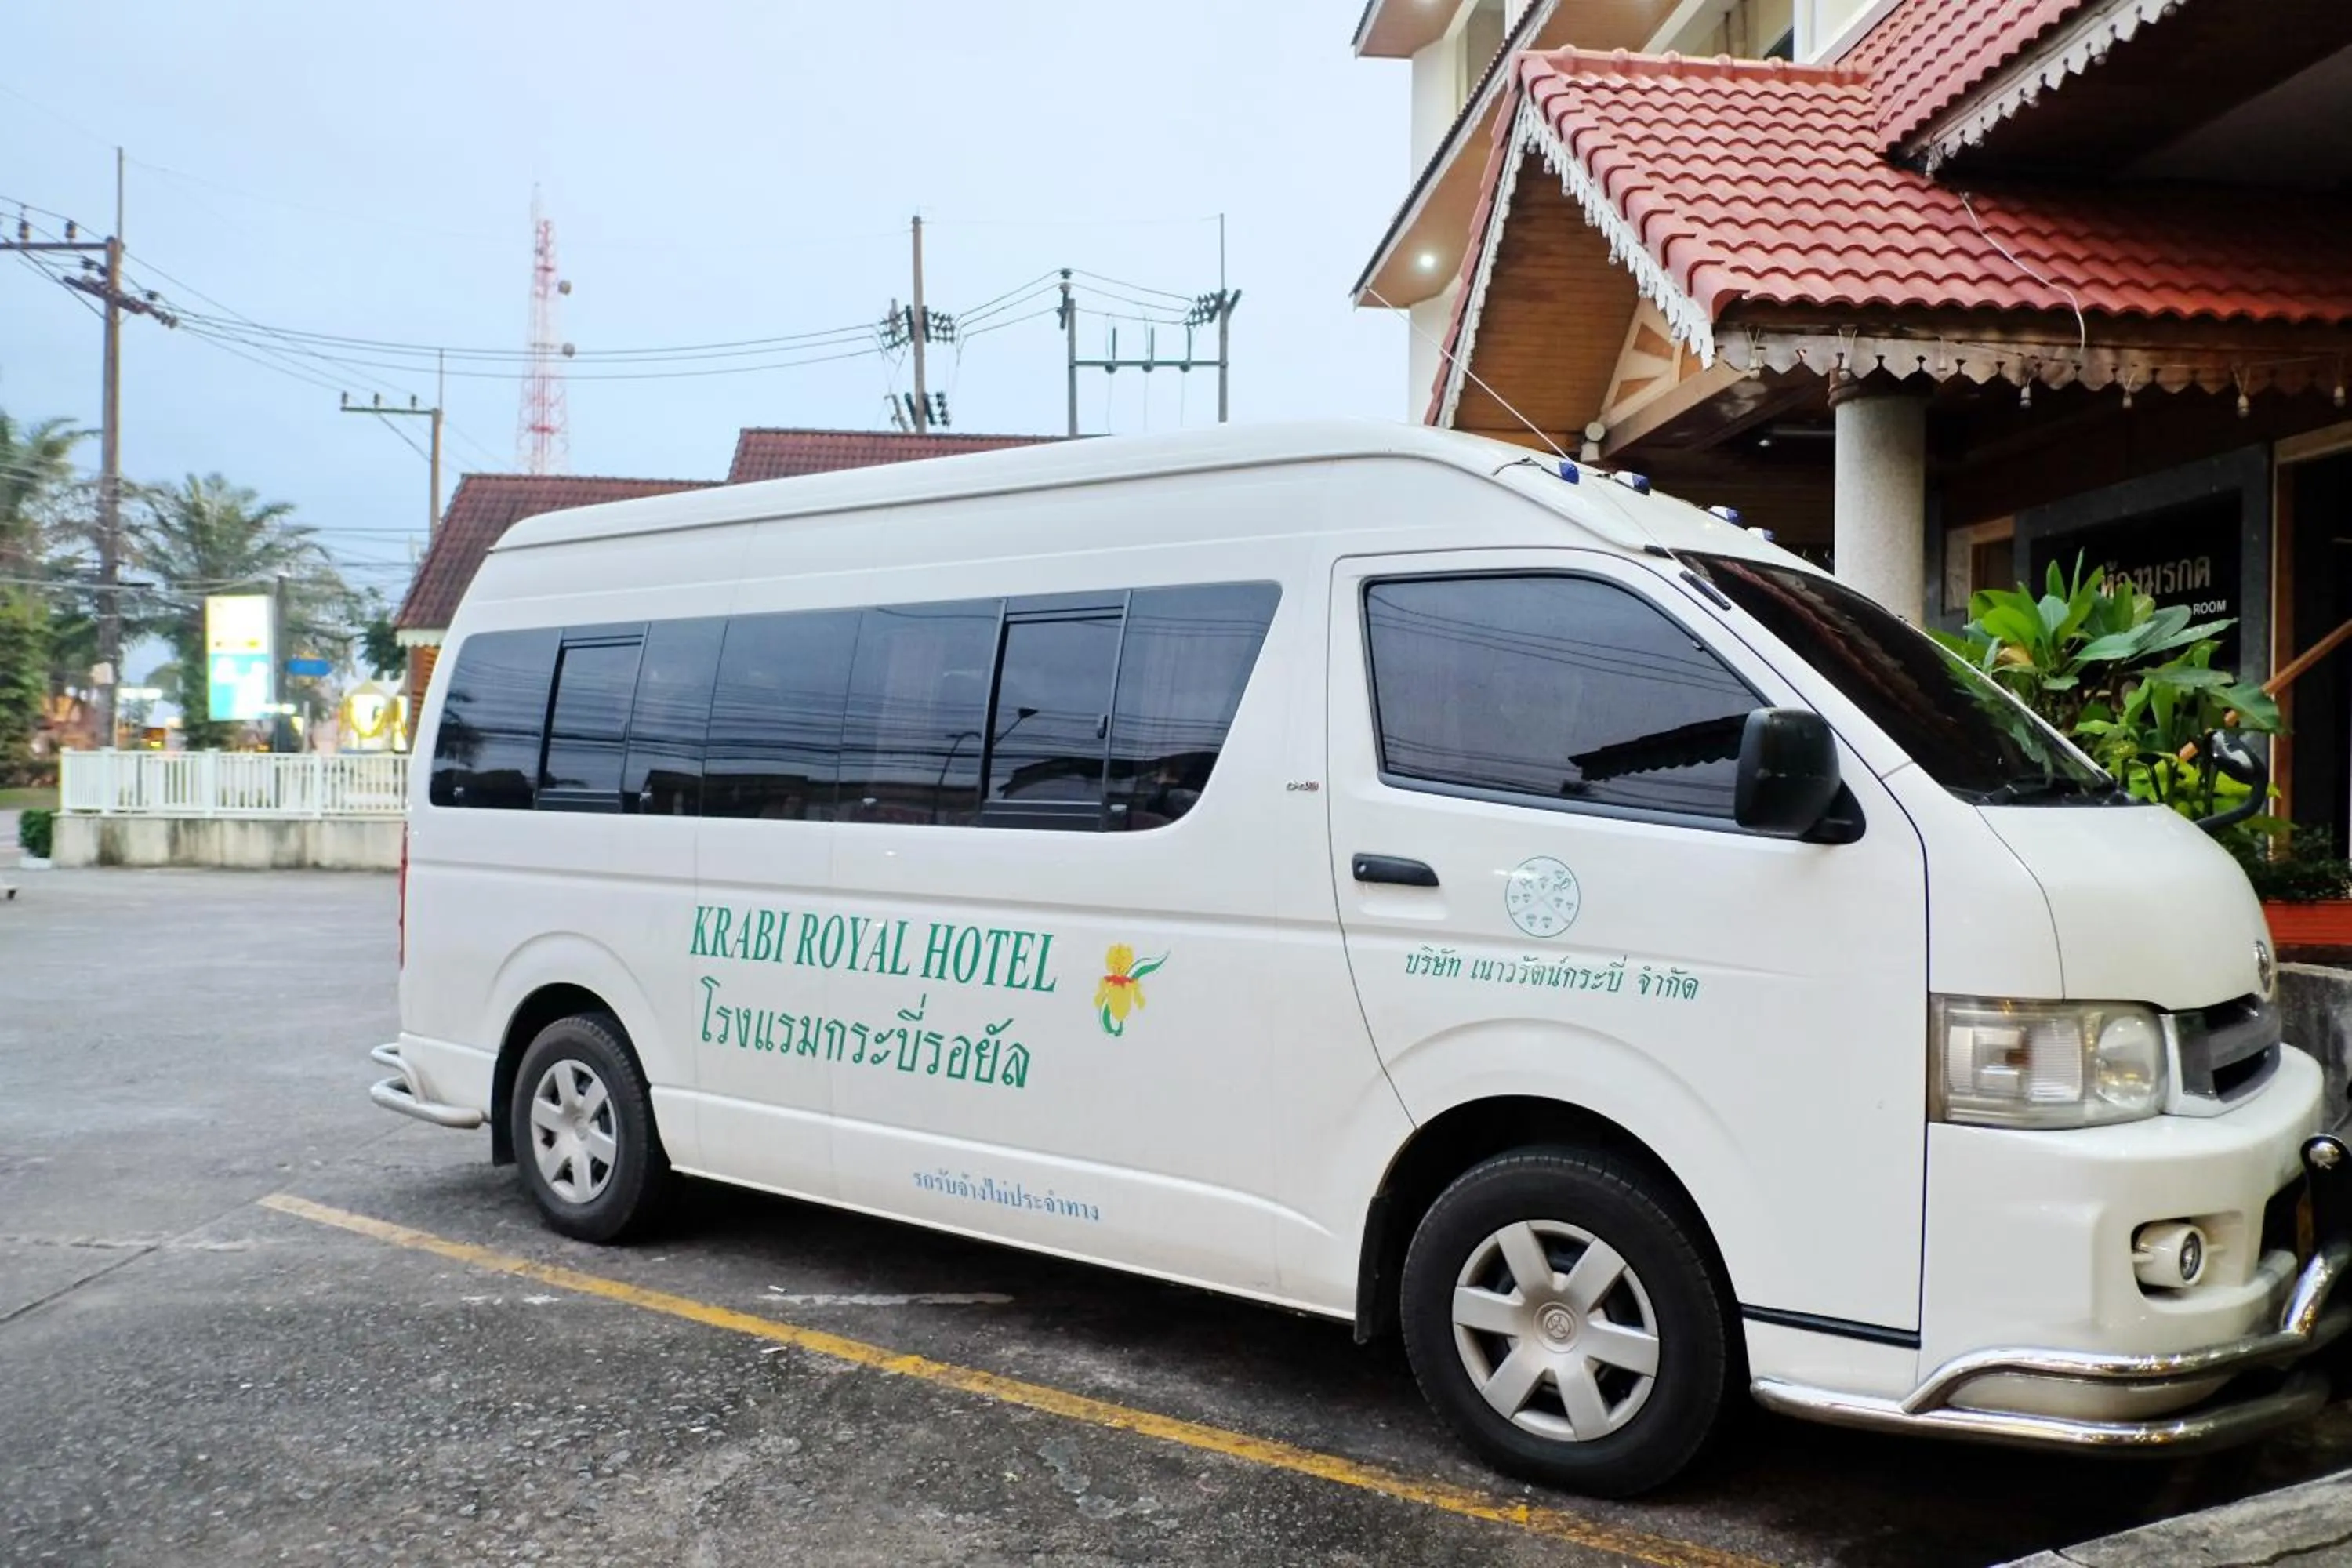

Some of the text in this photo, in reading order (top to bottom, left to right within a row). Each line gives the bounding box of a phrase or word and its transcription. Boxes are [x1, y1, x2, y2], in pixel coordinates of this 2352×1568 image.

[2193, 600, 2227, 615] ROOM
[690, 904, 1058, 993] KRABI ROYAL HOTEL
[1406, 946, 1463, 979] บริษัท
[1638, 965, 1700, 1000] จำกัด
[700, 976, 1031, 1089] โรงแรมกระบี่รอยัล
